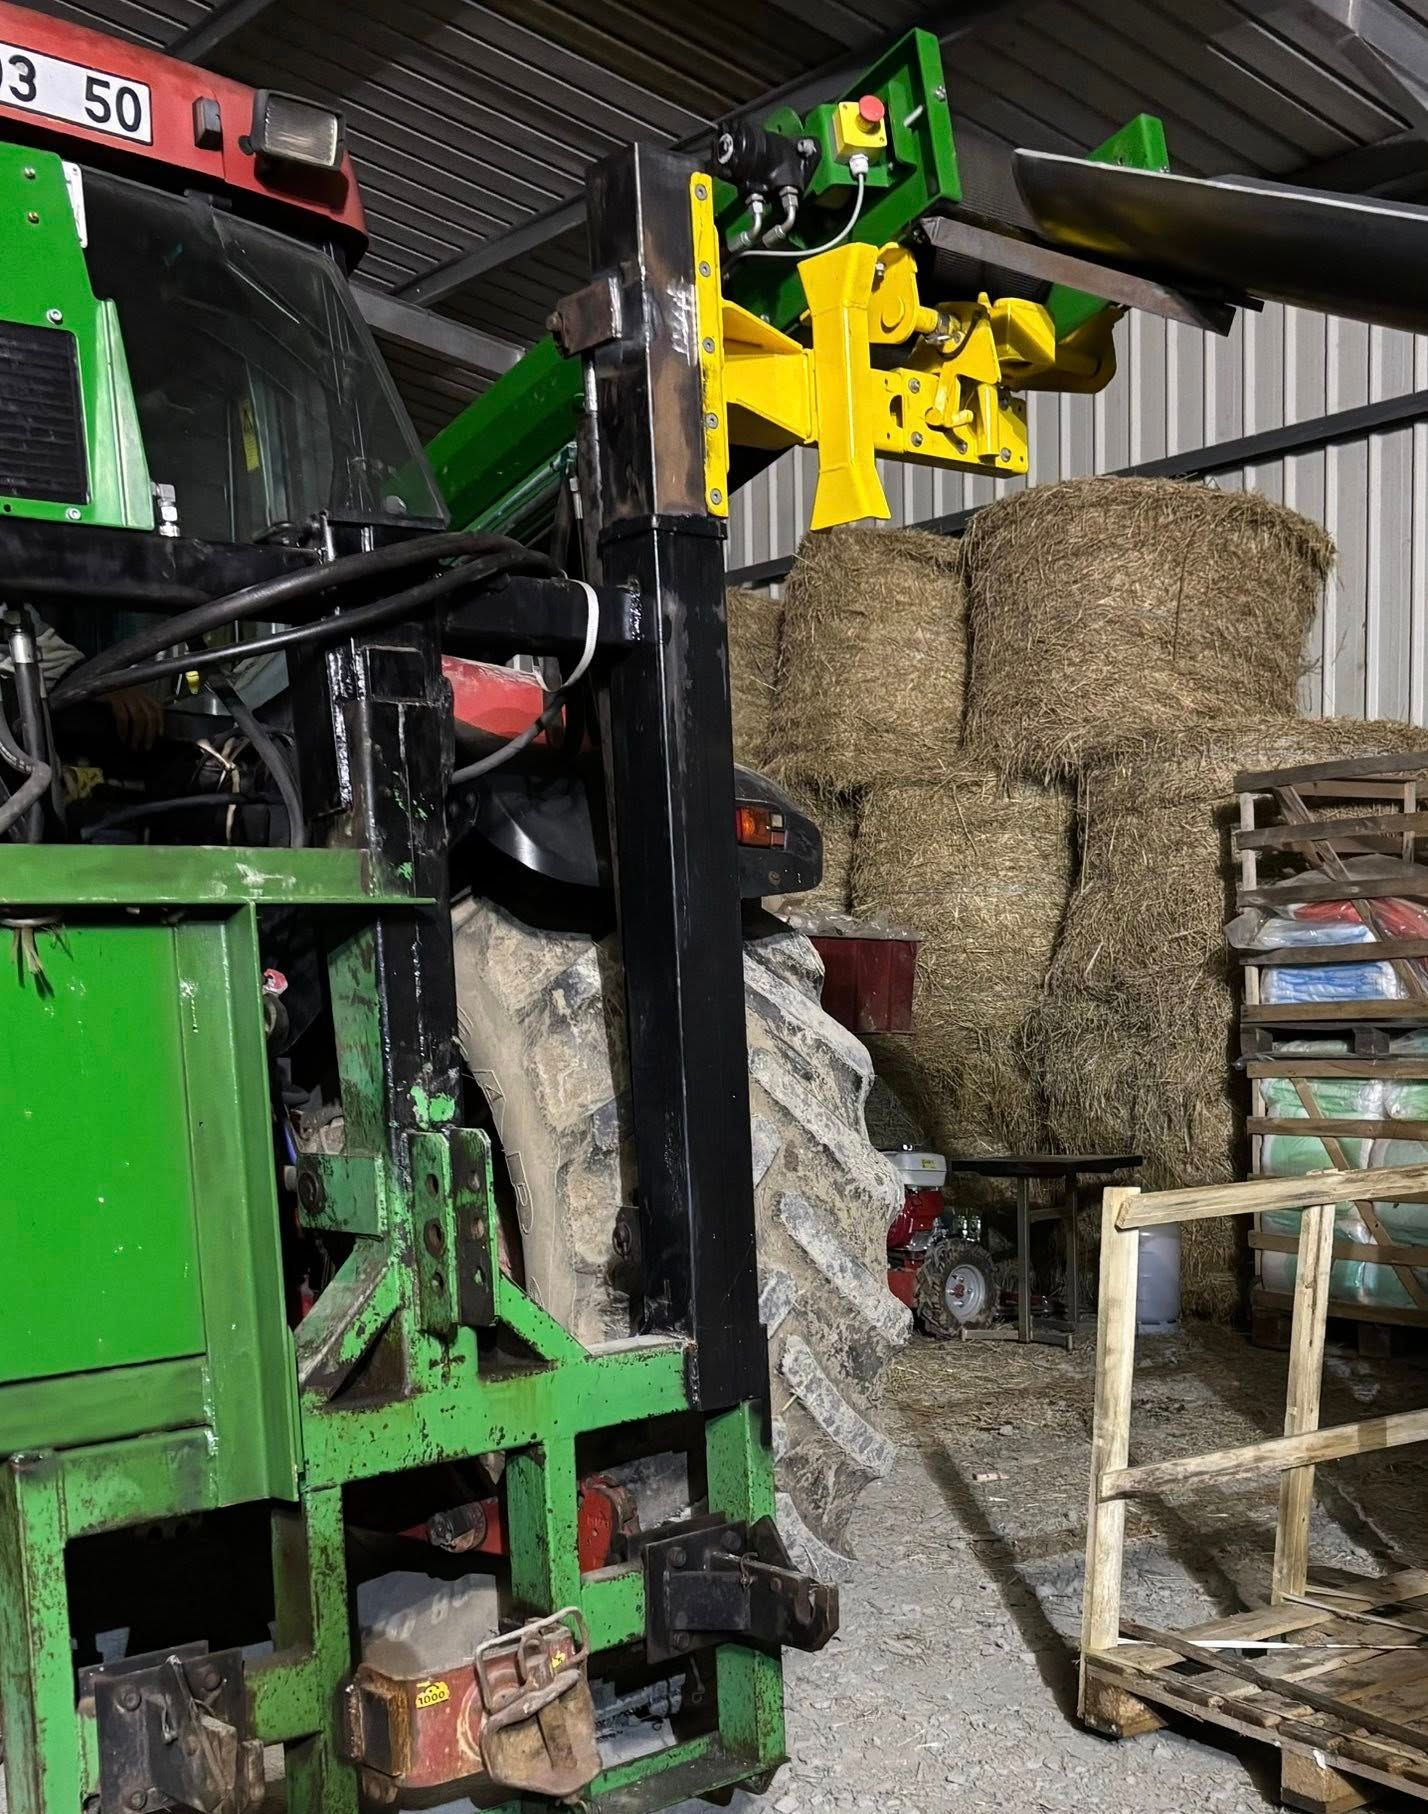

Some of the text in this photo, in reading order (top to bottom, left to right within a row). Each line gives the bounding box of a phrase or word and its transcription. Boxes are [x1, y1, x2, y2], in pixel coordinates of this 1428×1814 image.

[0, 54, 142, 132] 3 50
[419, 1690, 446, 1705] 1000
